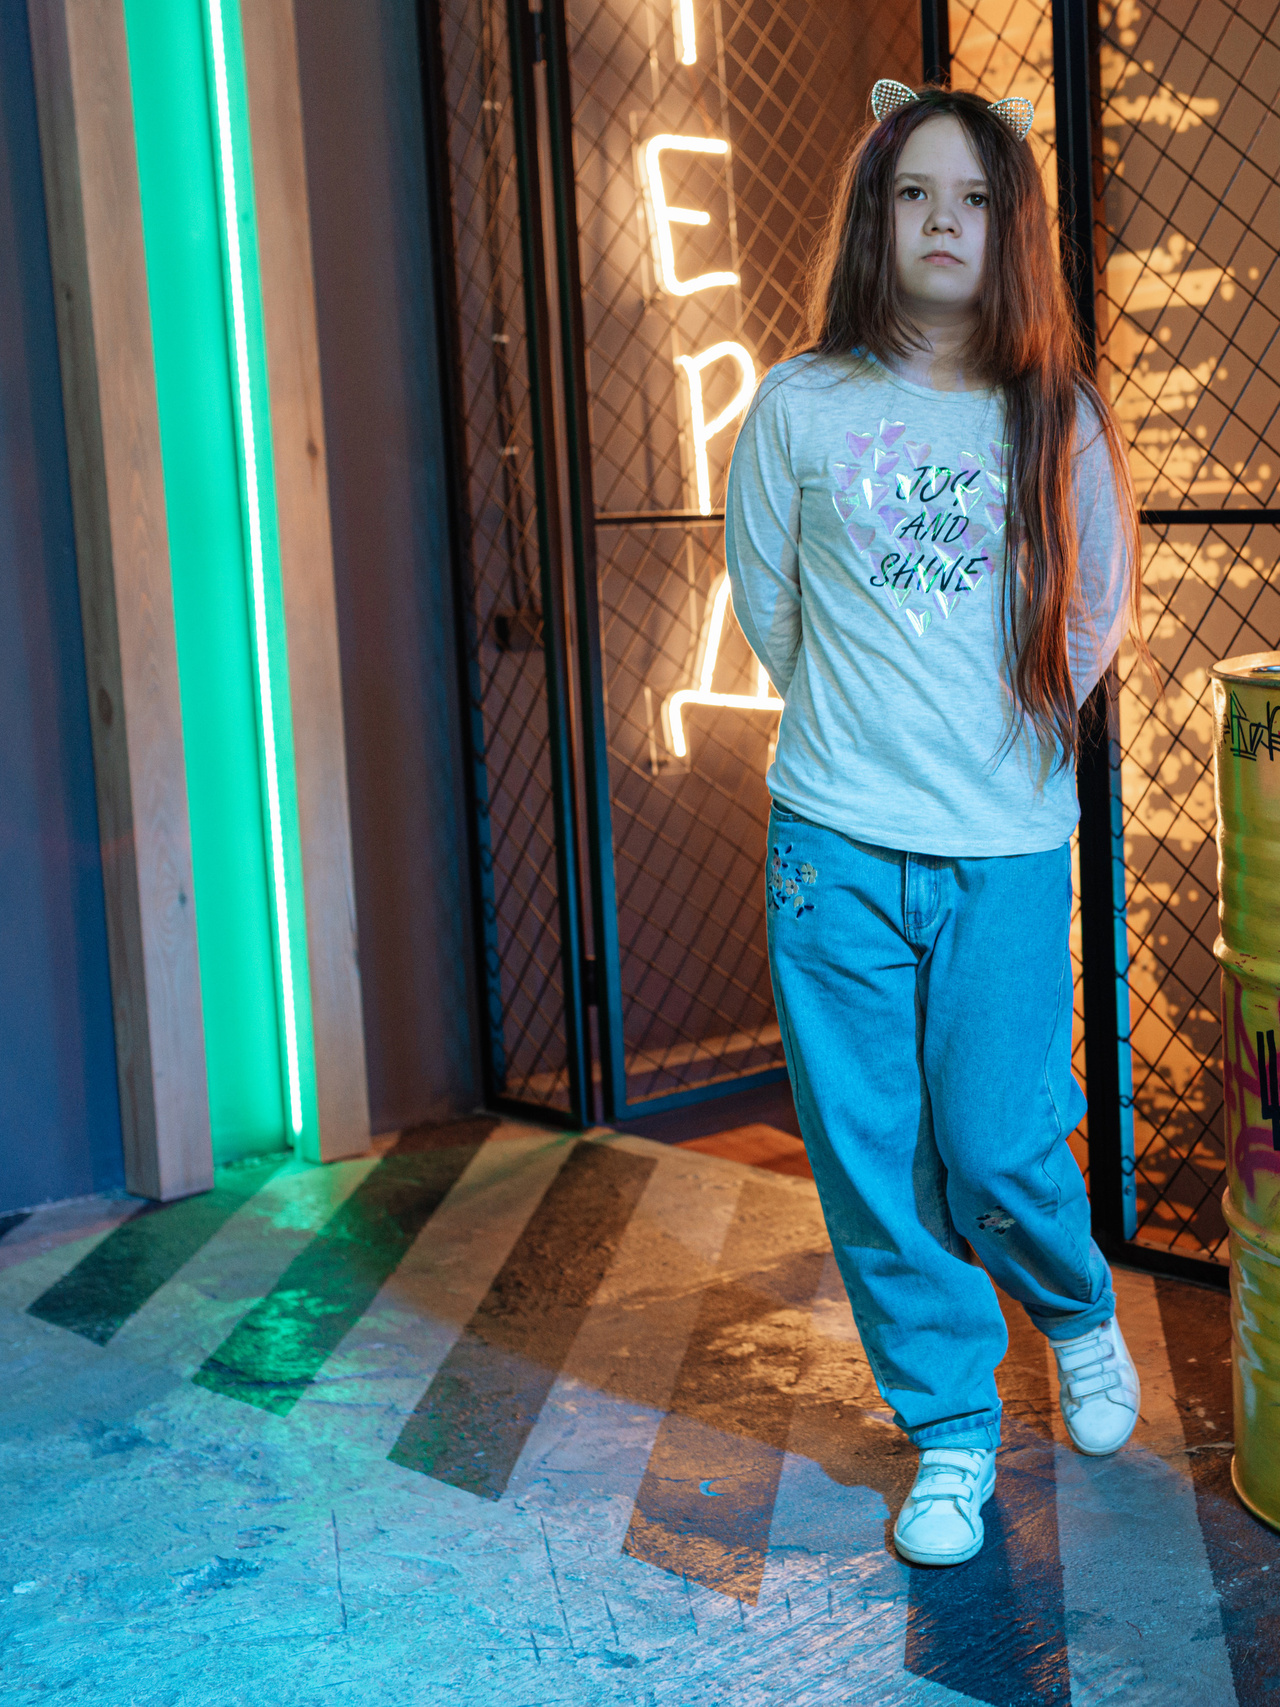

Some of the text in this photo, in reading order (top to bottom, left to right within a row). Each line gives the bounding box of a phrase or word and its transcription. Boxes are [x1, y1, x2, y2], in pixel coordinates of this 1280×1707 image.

[896, 465, 981, 507] JOY
[900, 512, 969, 543] AND
[870, 552, 989, 593] SHINE
